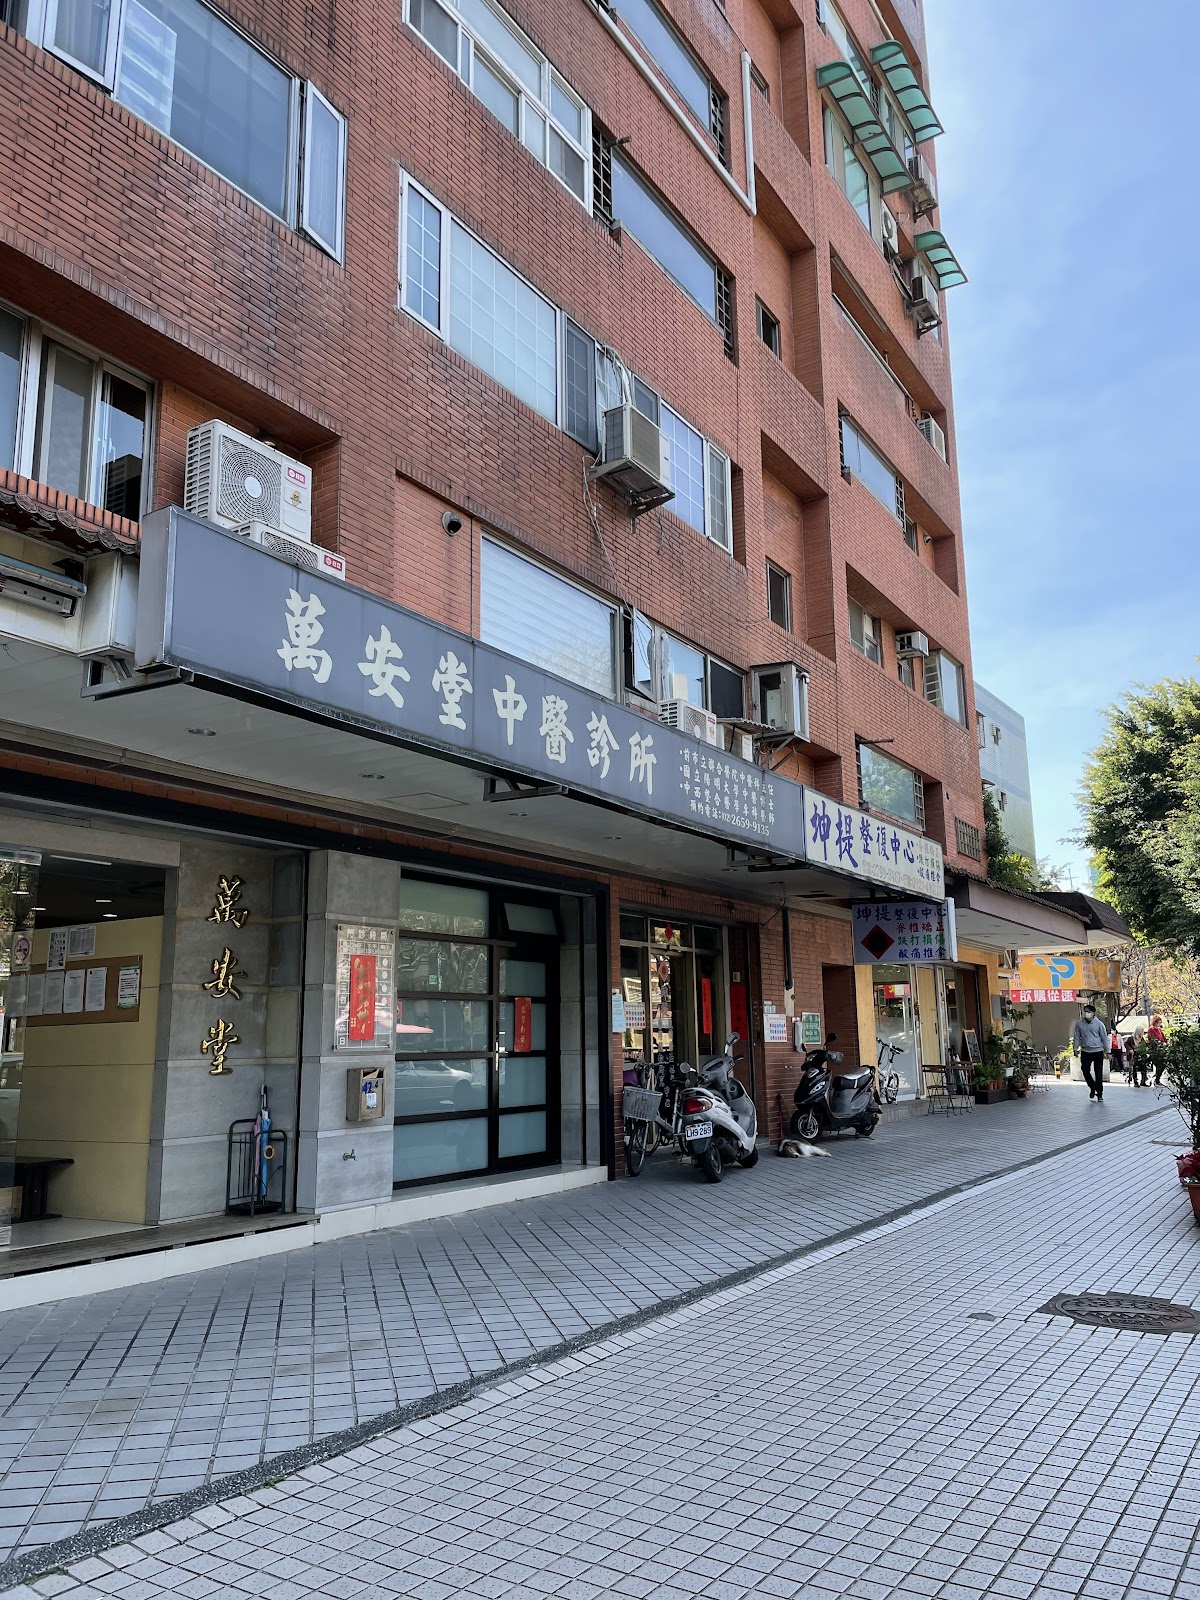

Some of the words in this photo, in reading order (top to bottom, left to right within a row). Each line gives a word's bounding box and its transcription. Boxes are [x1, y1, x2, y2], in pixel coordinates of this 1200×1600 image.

[277, 587, 657, 795] 萬安堂中醫診所
[810, 800, 915, 868] 坤提整復中心
[856, 905, 947, 922] 坤提整復中心
[896, 922, 945, 934] 脊椎矯正
[897, 934, 946, 946] 跌打損傷
[898, 947, 947, 959] 酸痛推拿
[200, 874, 250, 1076] 萬安堂
[1019, 989, 1074, 1002] 欲購從速
